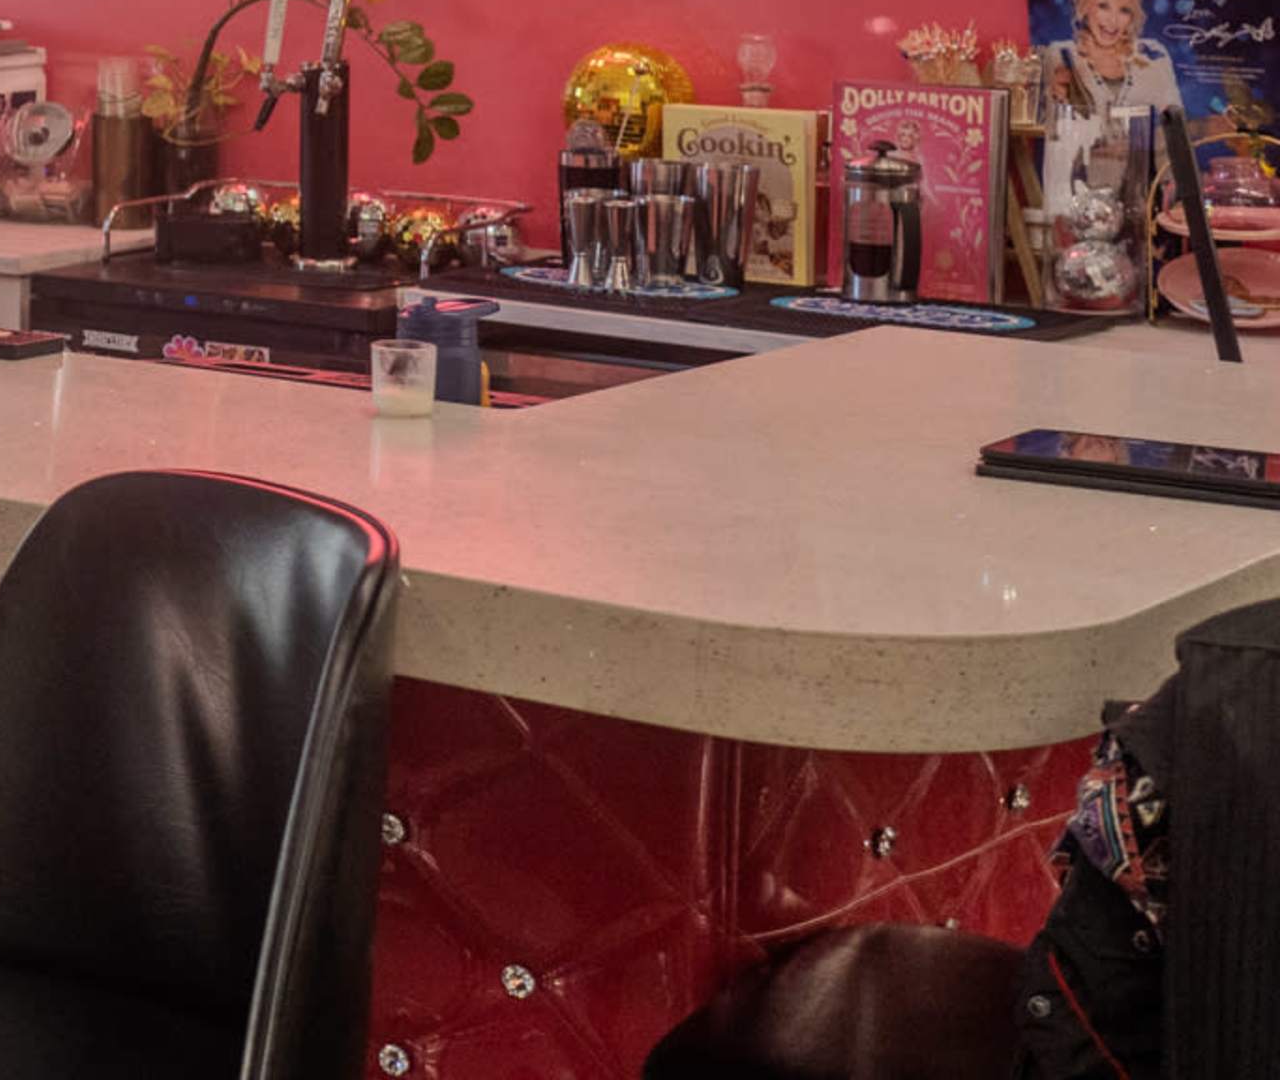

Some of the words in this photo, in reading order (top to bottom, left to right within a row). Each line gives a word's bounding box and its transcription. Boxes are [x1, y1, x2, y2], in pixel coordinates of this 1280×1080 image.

[841, 86, 904, 116] DOLLY
[907, 90, 985, 124] PARTON
[677, 126, 797, 167] Cookin'
